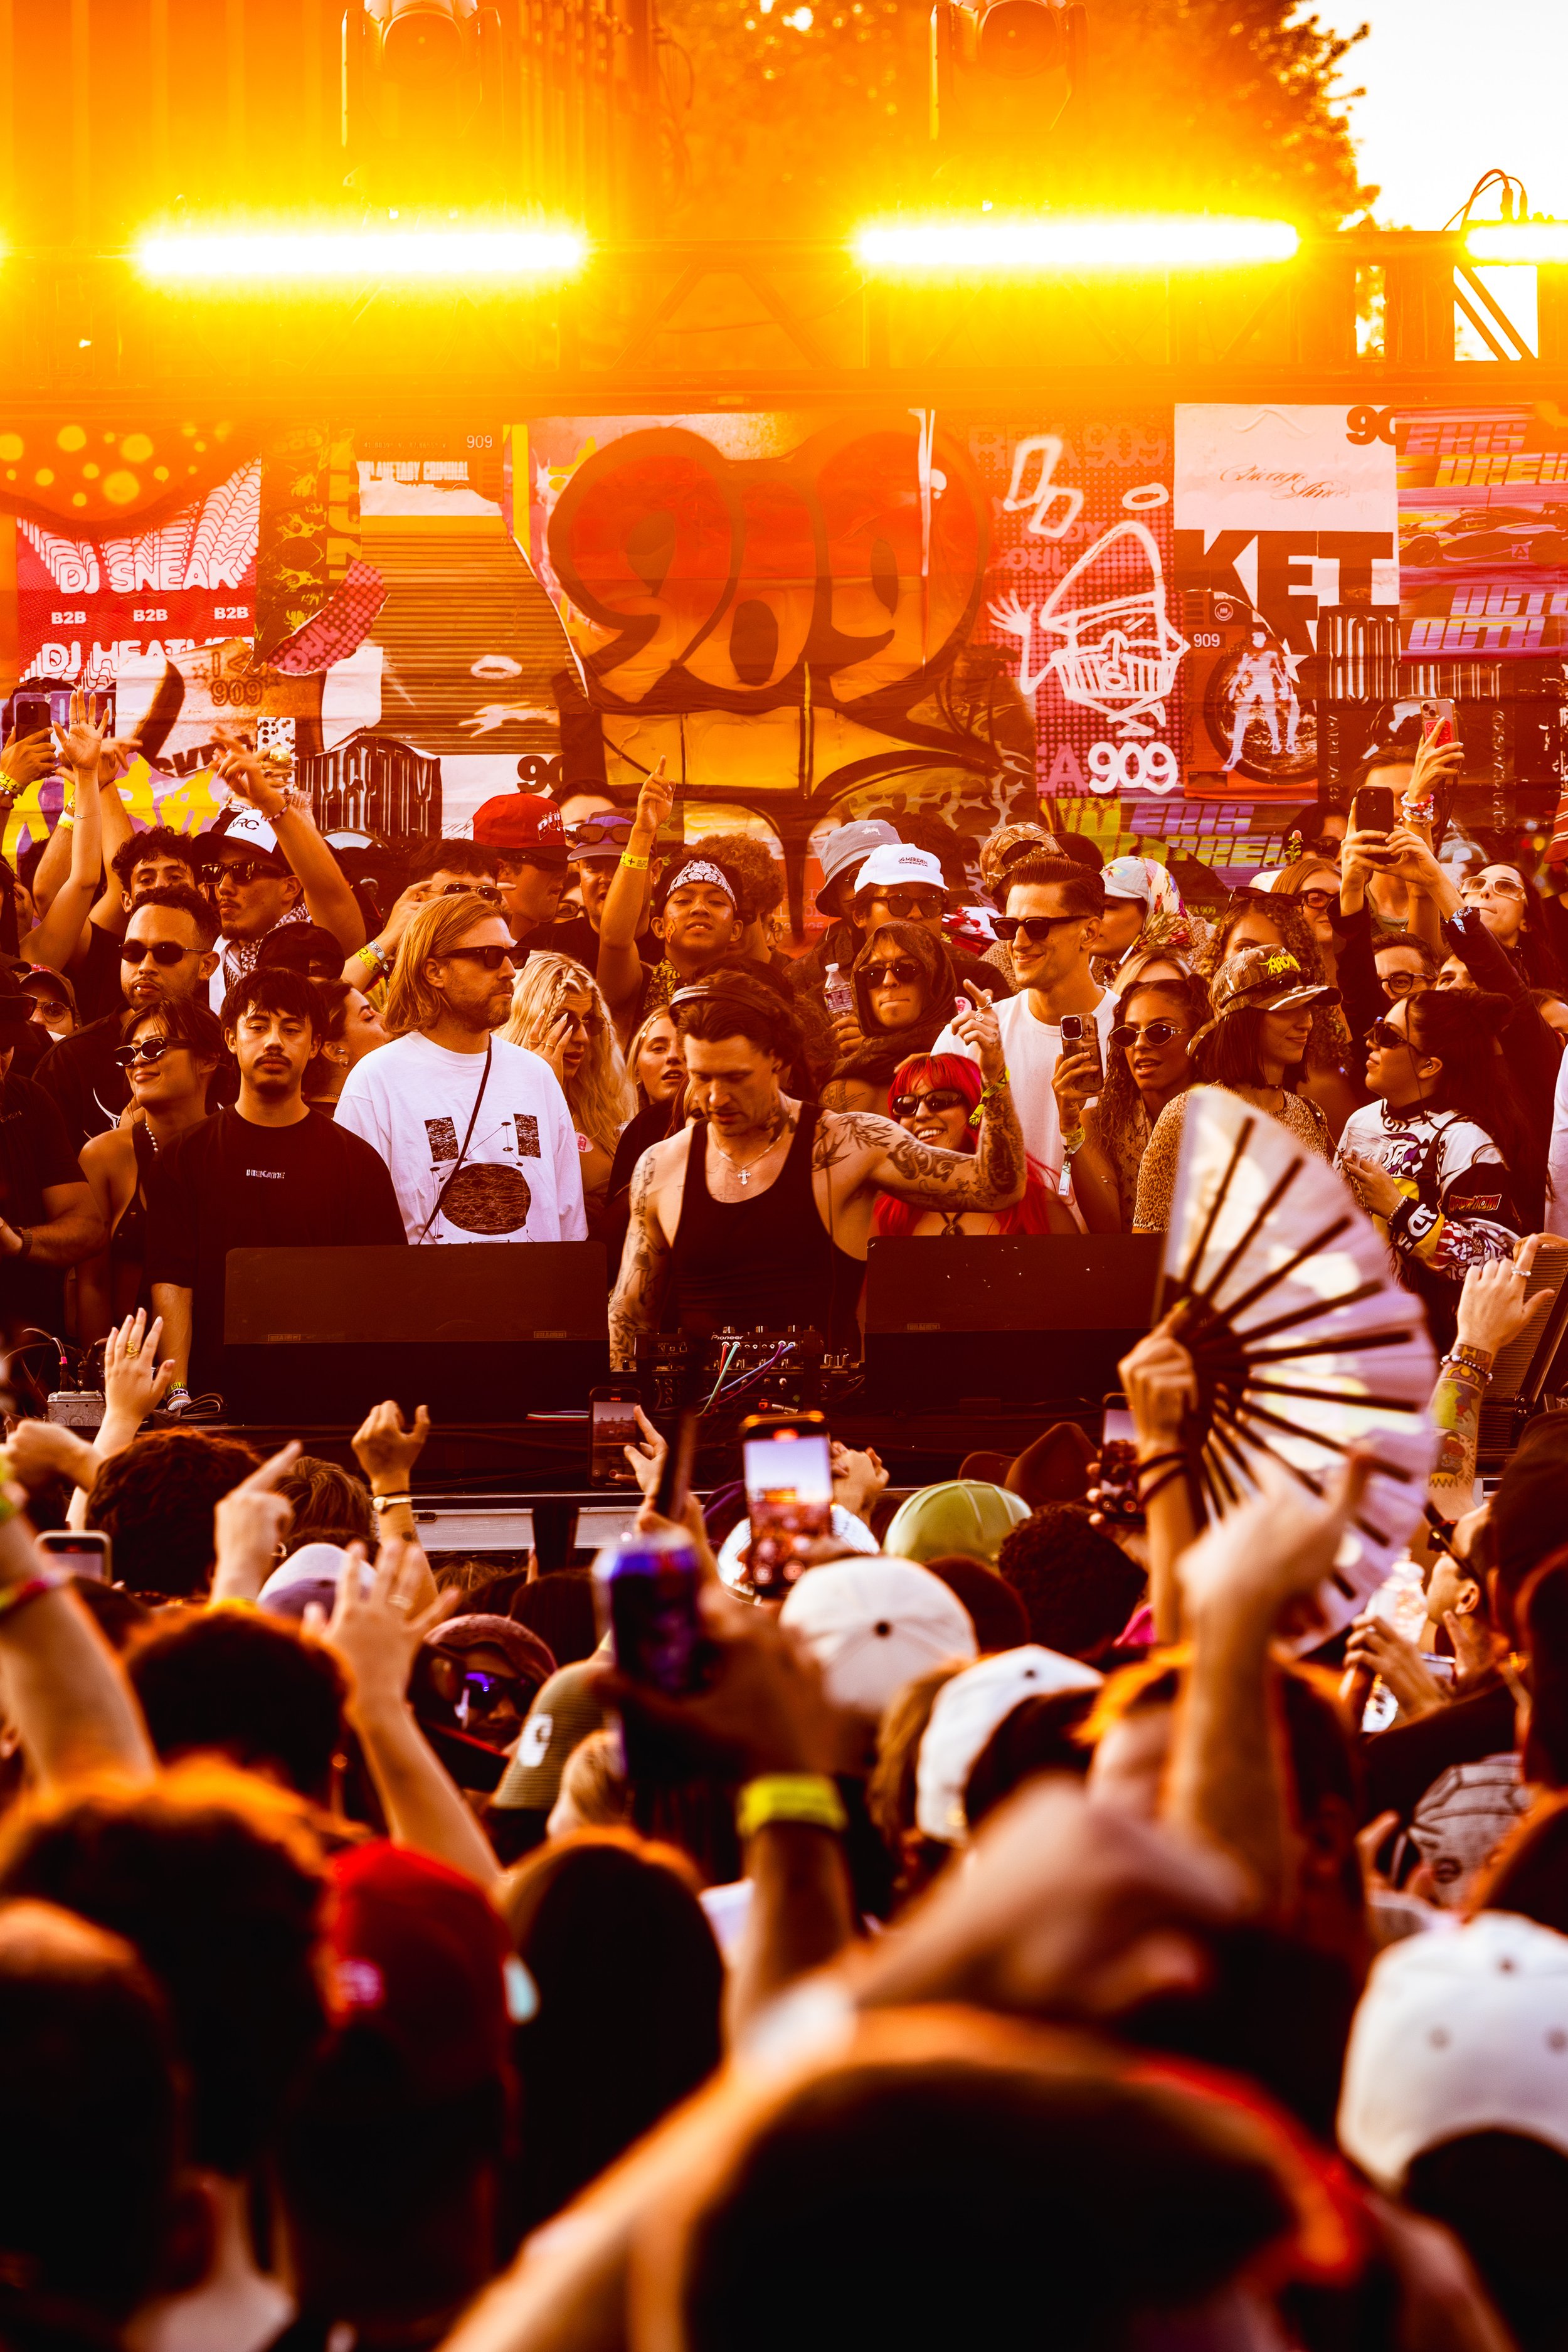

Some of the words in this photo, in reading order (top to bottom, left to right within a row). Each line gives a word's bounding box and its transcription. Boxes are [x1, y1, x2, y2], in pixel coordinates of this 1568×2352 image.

[467, 435, 492, 448] 909
[1404, 422, 1527, 455] ERIS
[60, 561, 100, 594] DJ
[110, 558, 239, 593] SNEAK
[51, 611, 87, 624] B2B
[133, 608, 168, 622] B2B
[214, 607, 249, 620] B2B
[1194, 633, 1221, 647] 909
[1408, 616, 1545, 650] OCTA
[41, 641, 82, 674] DJ
[93, 637, 255, 672] HEAT
[211, 679, 262, 706] 909
[1088, 741, 1179, 795] 909
[1130, 804, 1254, 835] ERIS
